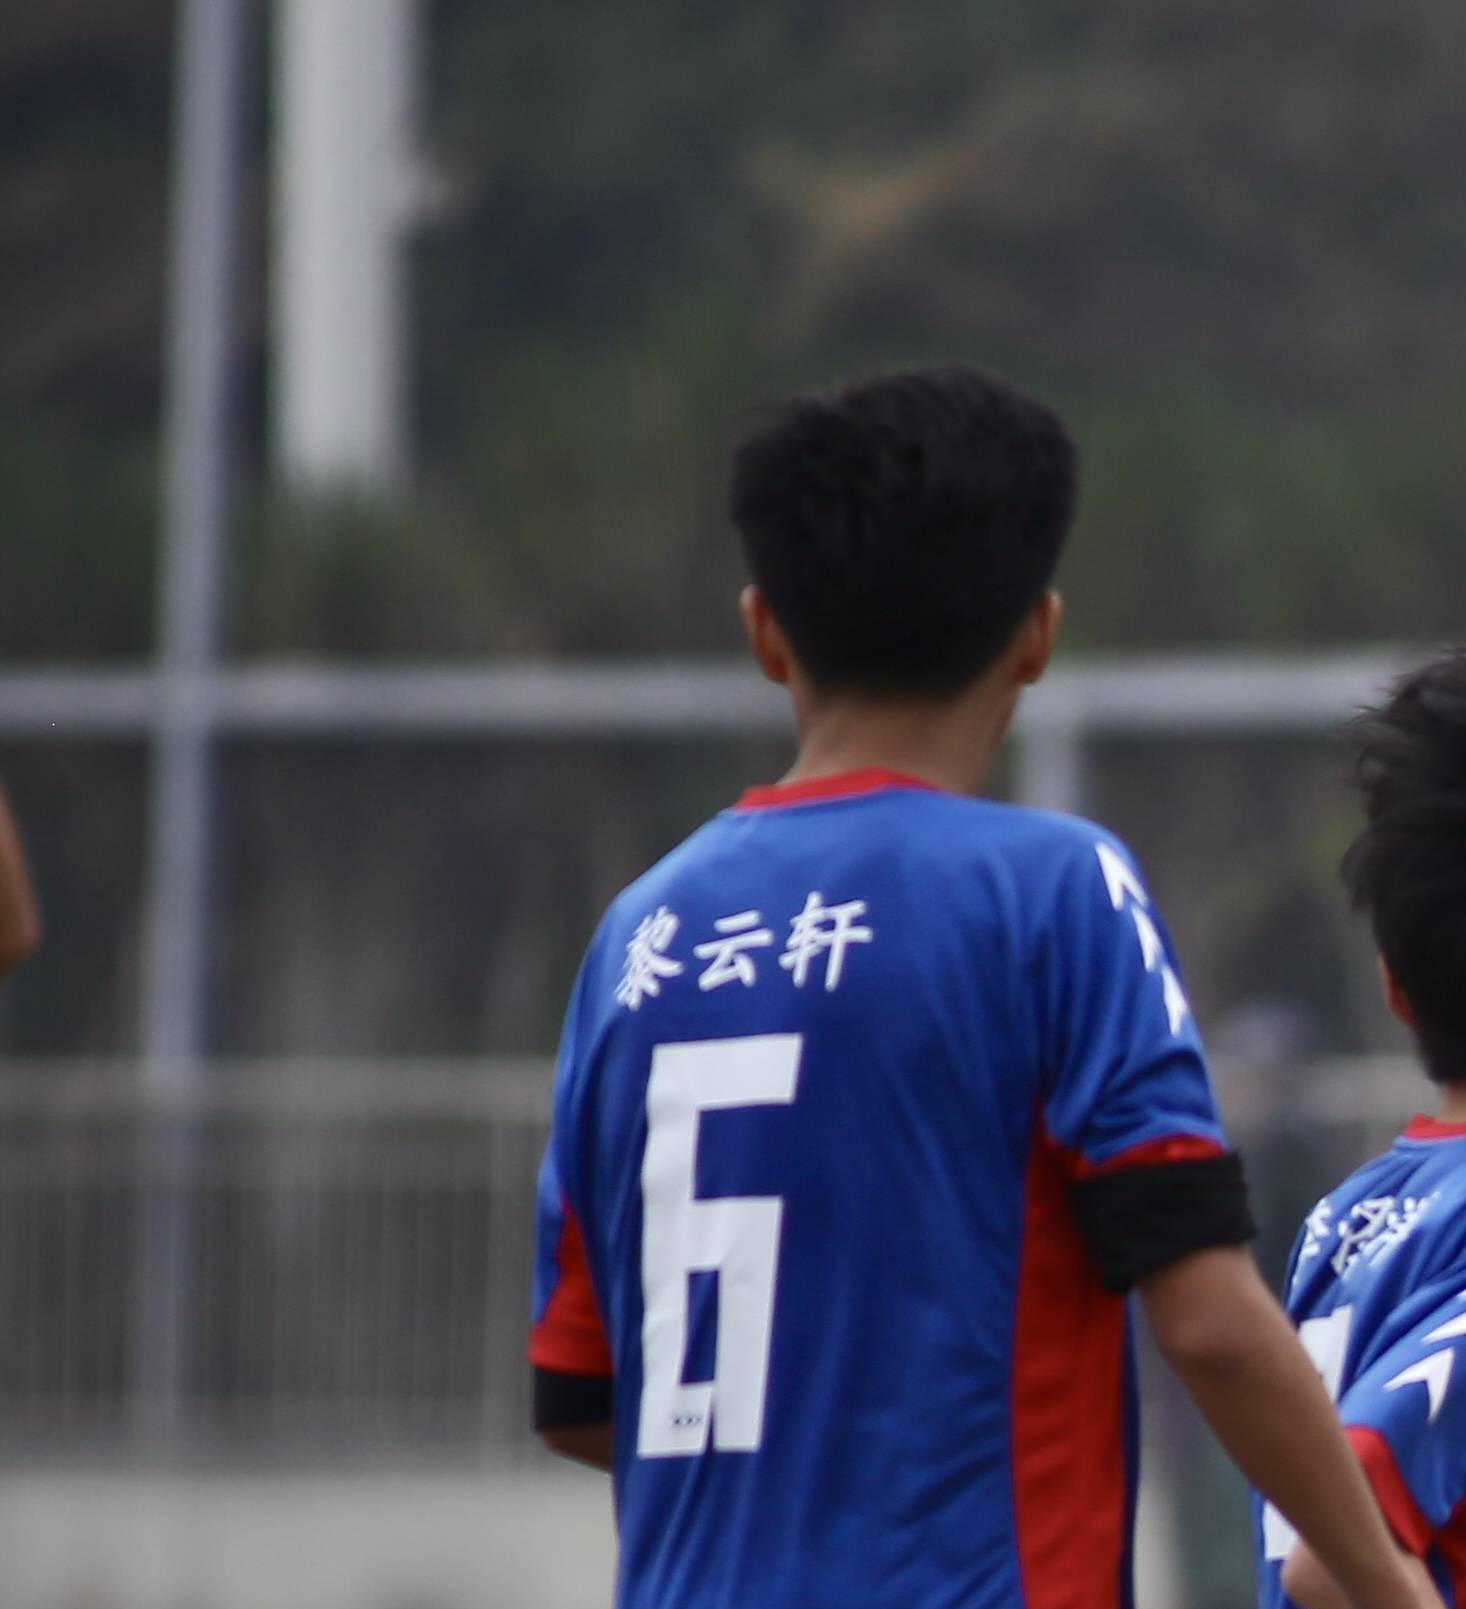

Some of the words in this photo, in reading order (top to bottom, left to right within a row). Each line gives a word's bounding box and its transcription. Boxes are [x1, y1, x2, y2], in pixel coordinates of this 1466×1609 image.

[616, 891, 873, 1010] 黎云轩
[637, 1033, 802, 1459] 6
